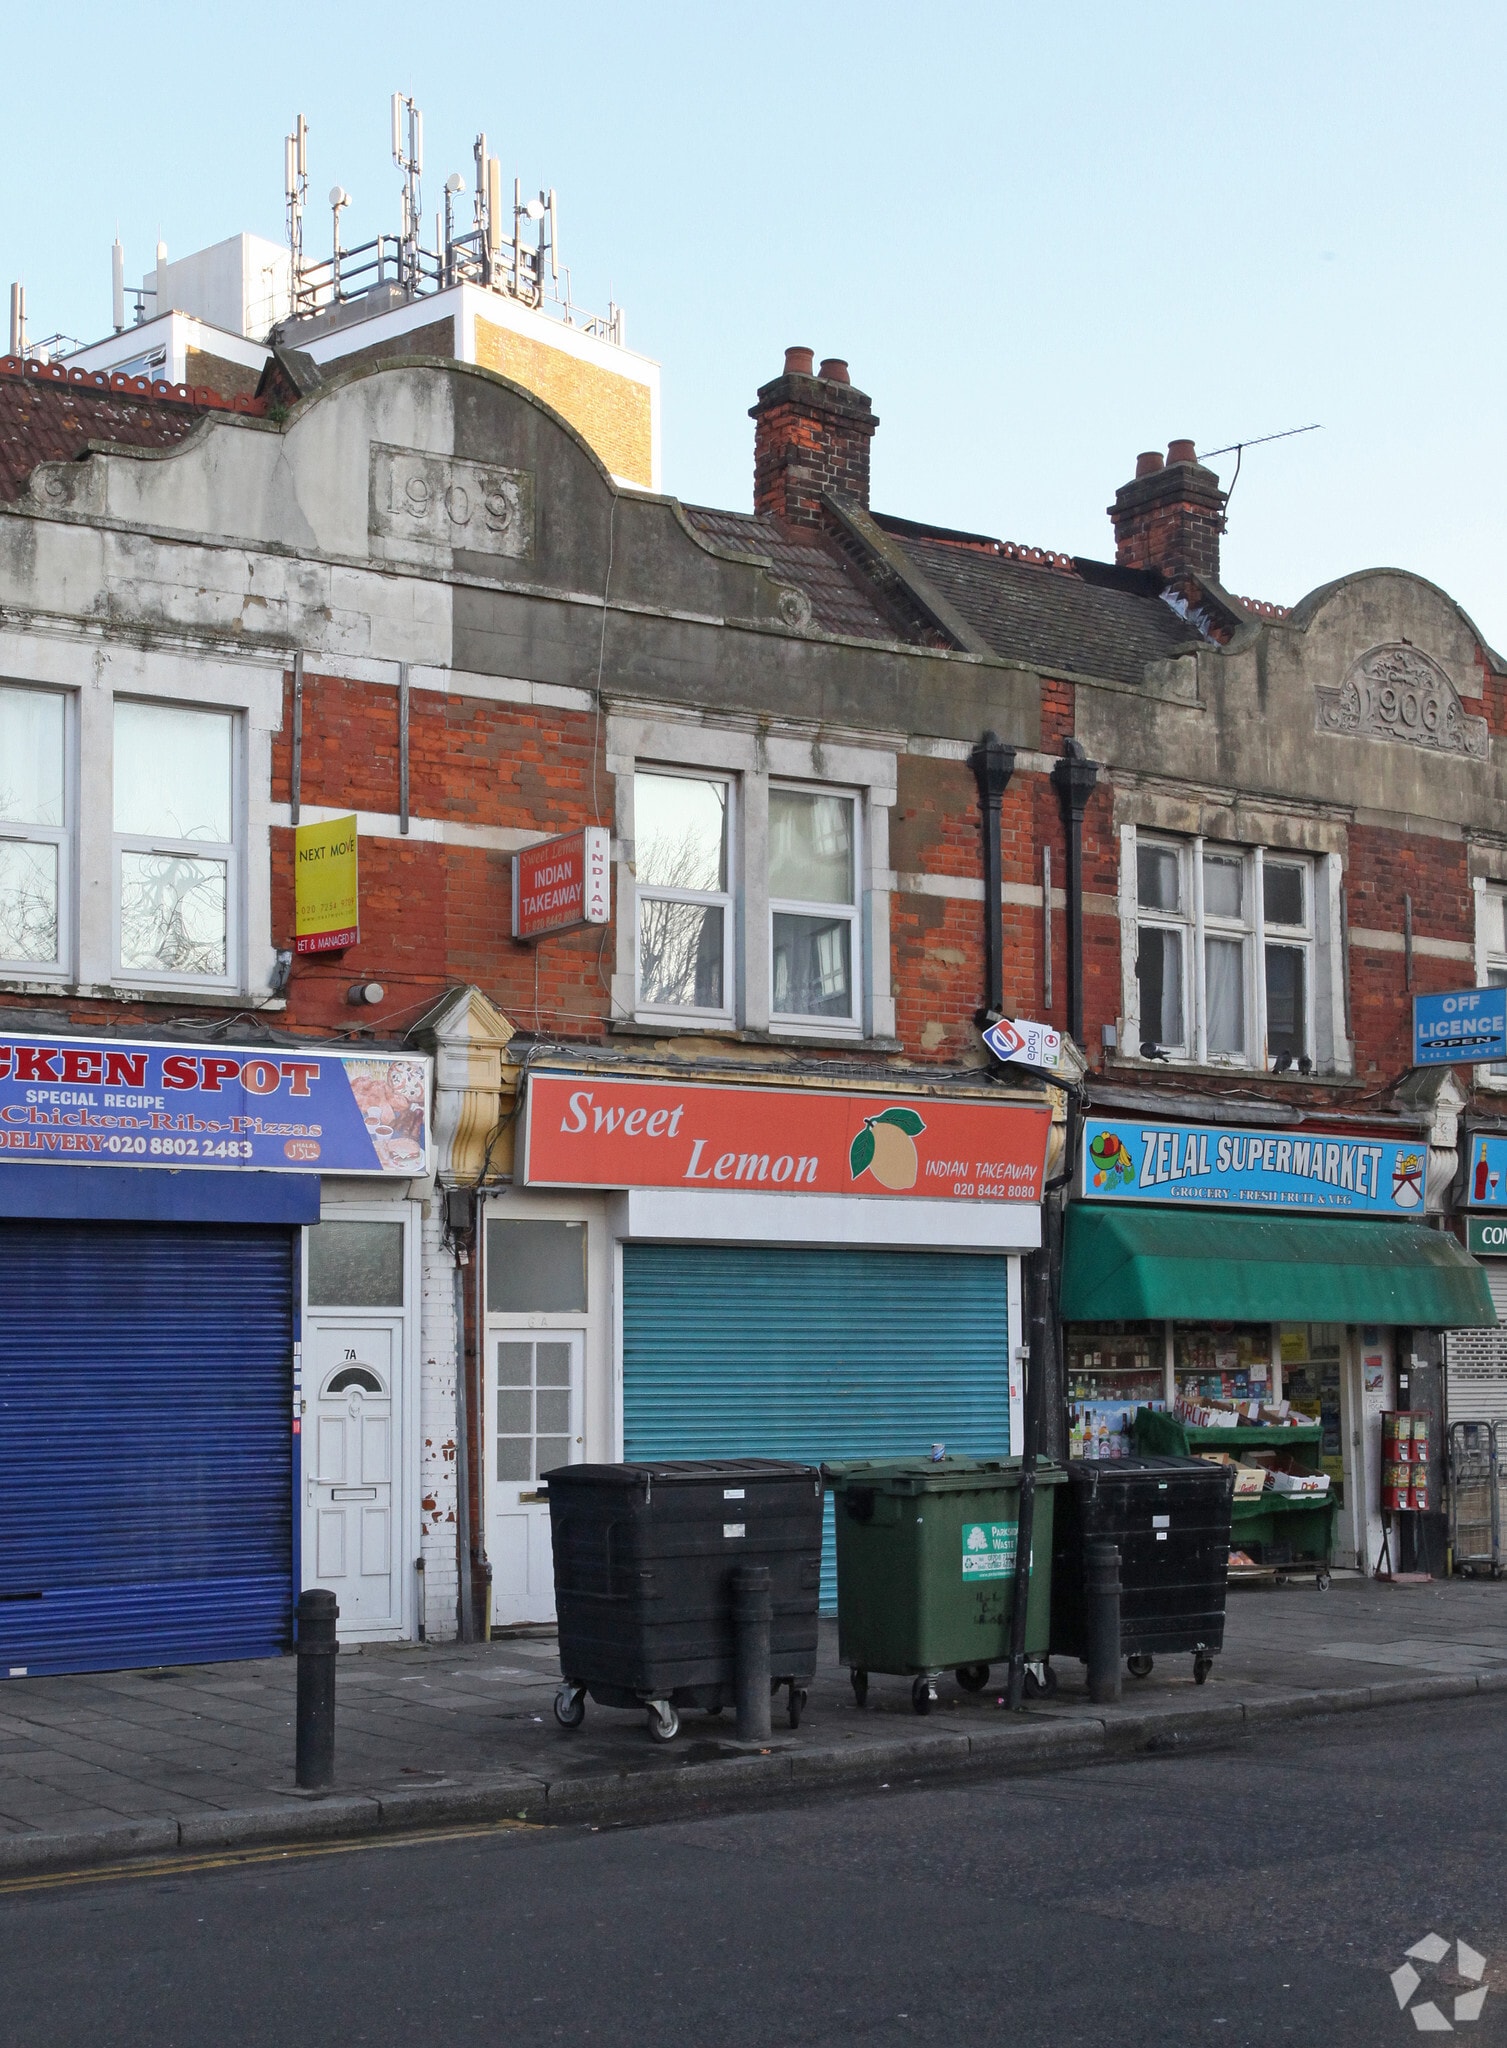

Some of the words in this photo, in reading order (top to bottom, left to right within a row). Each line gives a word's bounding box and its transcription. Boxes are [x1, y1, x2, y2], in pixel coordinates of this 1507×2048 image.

[1365, 687, 1438, 732] 1906
[300, 846, 326, 862] NEXT
[331, 837, 355, 857] MOVE
[534, 861, 572, 889] INDIAN
[591, 840, 604, 916] INDIAN
[302, 904, 315, 914] 020
[523, 882, 583, 916] TAKEAWAY
[298, 940, 309, 951] LET
[310, 938, 316, 950] &
[318, 933, 350, 949] MANAGED
[1442, 995, 1480, 1013] OFF
[1418, 1015, 1504, 1038] LICENCE
[1027, 1030, 1040, 1060] epay
[1420, 1051, 1454, 1059] TILL
[1461, 1047, 1503, 1055] LATE
[1430, 1037, 1491, 1047] OPEN
[162, 1055, 320, 1097] SPOT
[26, 1089, 98, 1106] SPECIAL
[104, 1093, 165, 1109] RECIPE
[560, 1091, 684, 1137] Sweet
[150, 1137, 200, 1156] 8802
[202, 1139, 253, 1159] 2483
[682, 1139, 818, 1183] Lemon
[925, 1160, 968, 1177] INDIAN
[975, 1162, 1037, 1181] TAKEAWAY
[1139, 1130, 1211, 1189] ZELAL
[1216, 1135, 1382, 1199] SUPERMARKET
[953, 1183, 975, 1195] 020
[977, 1184, 1005, 1196] 8442
[1007, 1185, 1035, 1197] 8080
[1170, 1186, 1230, 1200] GROCERY
[1239, 1189, 1277, 1201] FRESH
[1280, 1191, 1315, 1203] FRUIT
[1317, 1195, 1325, 1204] &
[1328, 1195, 1351, 1205] VEG
[344, 1349, 357, 1360] 7A
[1174, 1394, 1210, 1428] GARLIC
